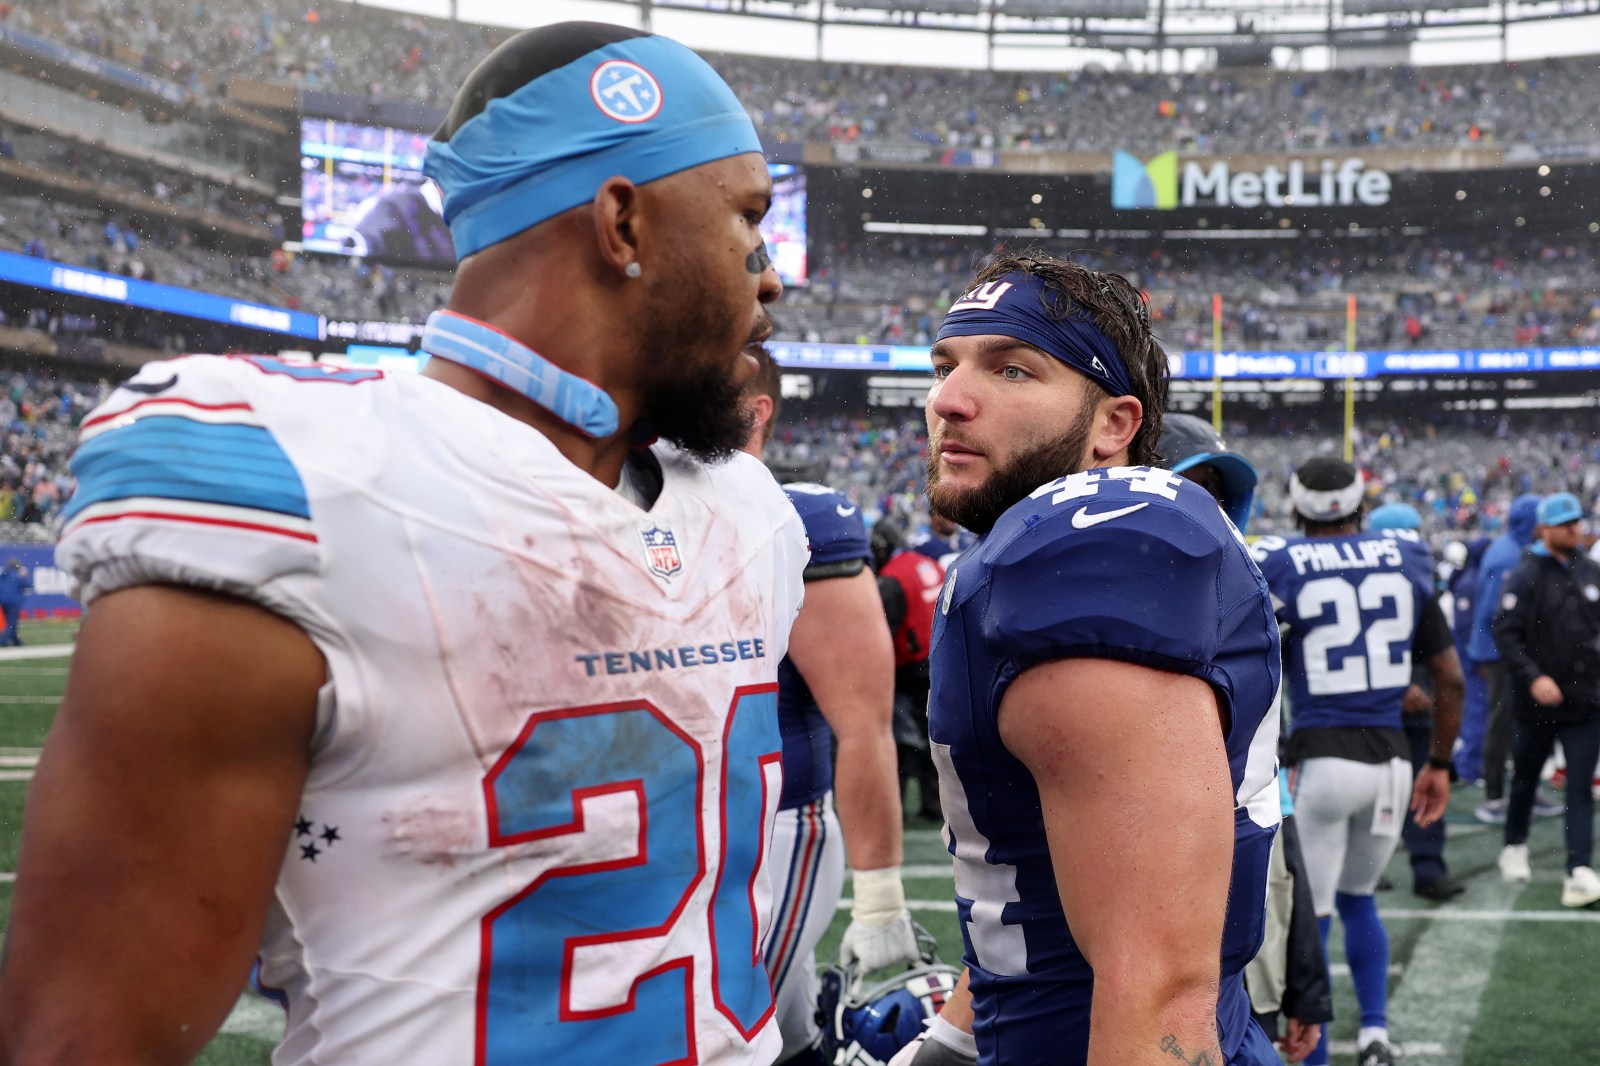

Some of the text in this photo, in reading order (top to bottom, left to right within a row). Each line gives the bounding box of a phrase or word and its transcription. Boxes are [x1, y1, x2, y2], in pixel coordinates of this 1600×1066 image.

[1182, 157, 1392, 207] MetLife
[1028, 465, 1183, 505] 44
[650, 547, 679, 571] NFL
[1287, 538, 1403, 576] PHILLIPS
[1296, 571, 1414, 696] 22
[575, 637, 766, 677] TENNESSEE
[474, 681, 784, 1066] 20
